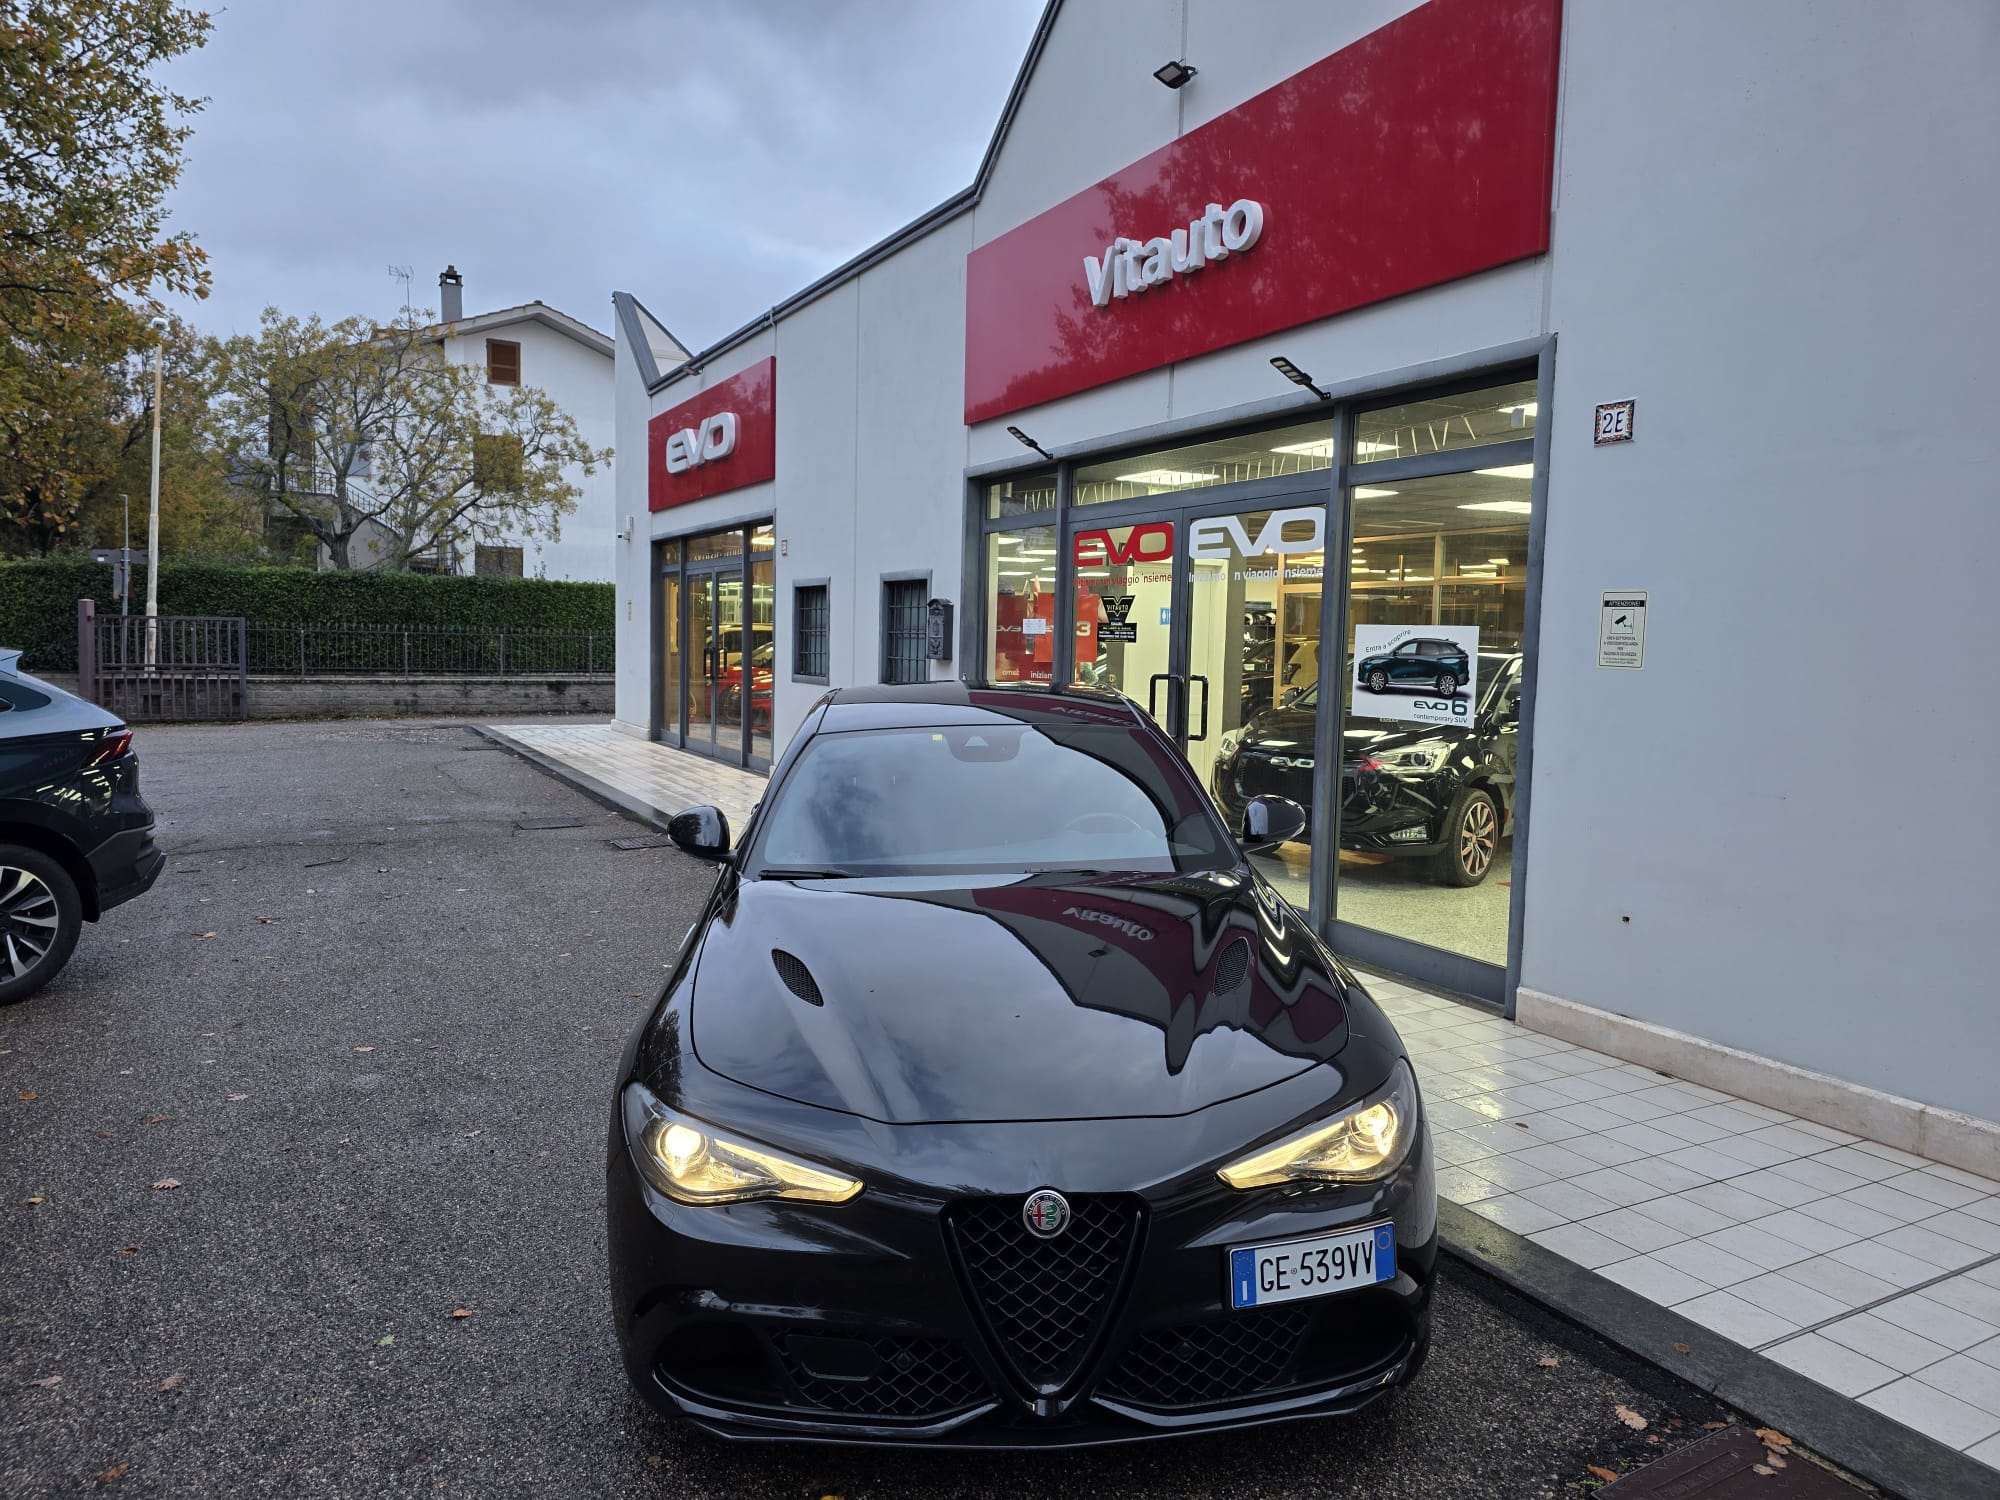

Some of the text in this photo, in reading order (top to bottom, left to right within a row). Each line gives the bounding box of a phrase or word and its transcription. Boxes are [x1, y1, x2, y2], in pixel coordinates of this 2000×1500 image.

[1083, 198, 1263, 306] Vitauto
[666, 412, 735, 473] EVO
[1602, 410, 1625, 434] 2E
[1073, 522, 1174, 567] EVO
[1189, 507, 1326, 559] EVO
[1365, 645, 1382, 653] Entra
[1388, 629, 1411, 647] scoprire
[1413, 697, 1468, 716] EVO 6
[1413, 713, 1454, 723] contemporary
[1260, 1255, 1290, 1292] GE
[1300, 1240, 1373, 1285] 539VV
